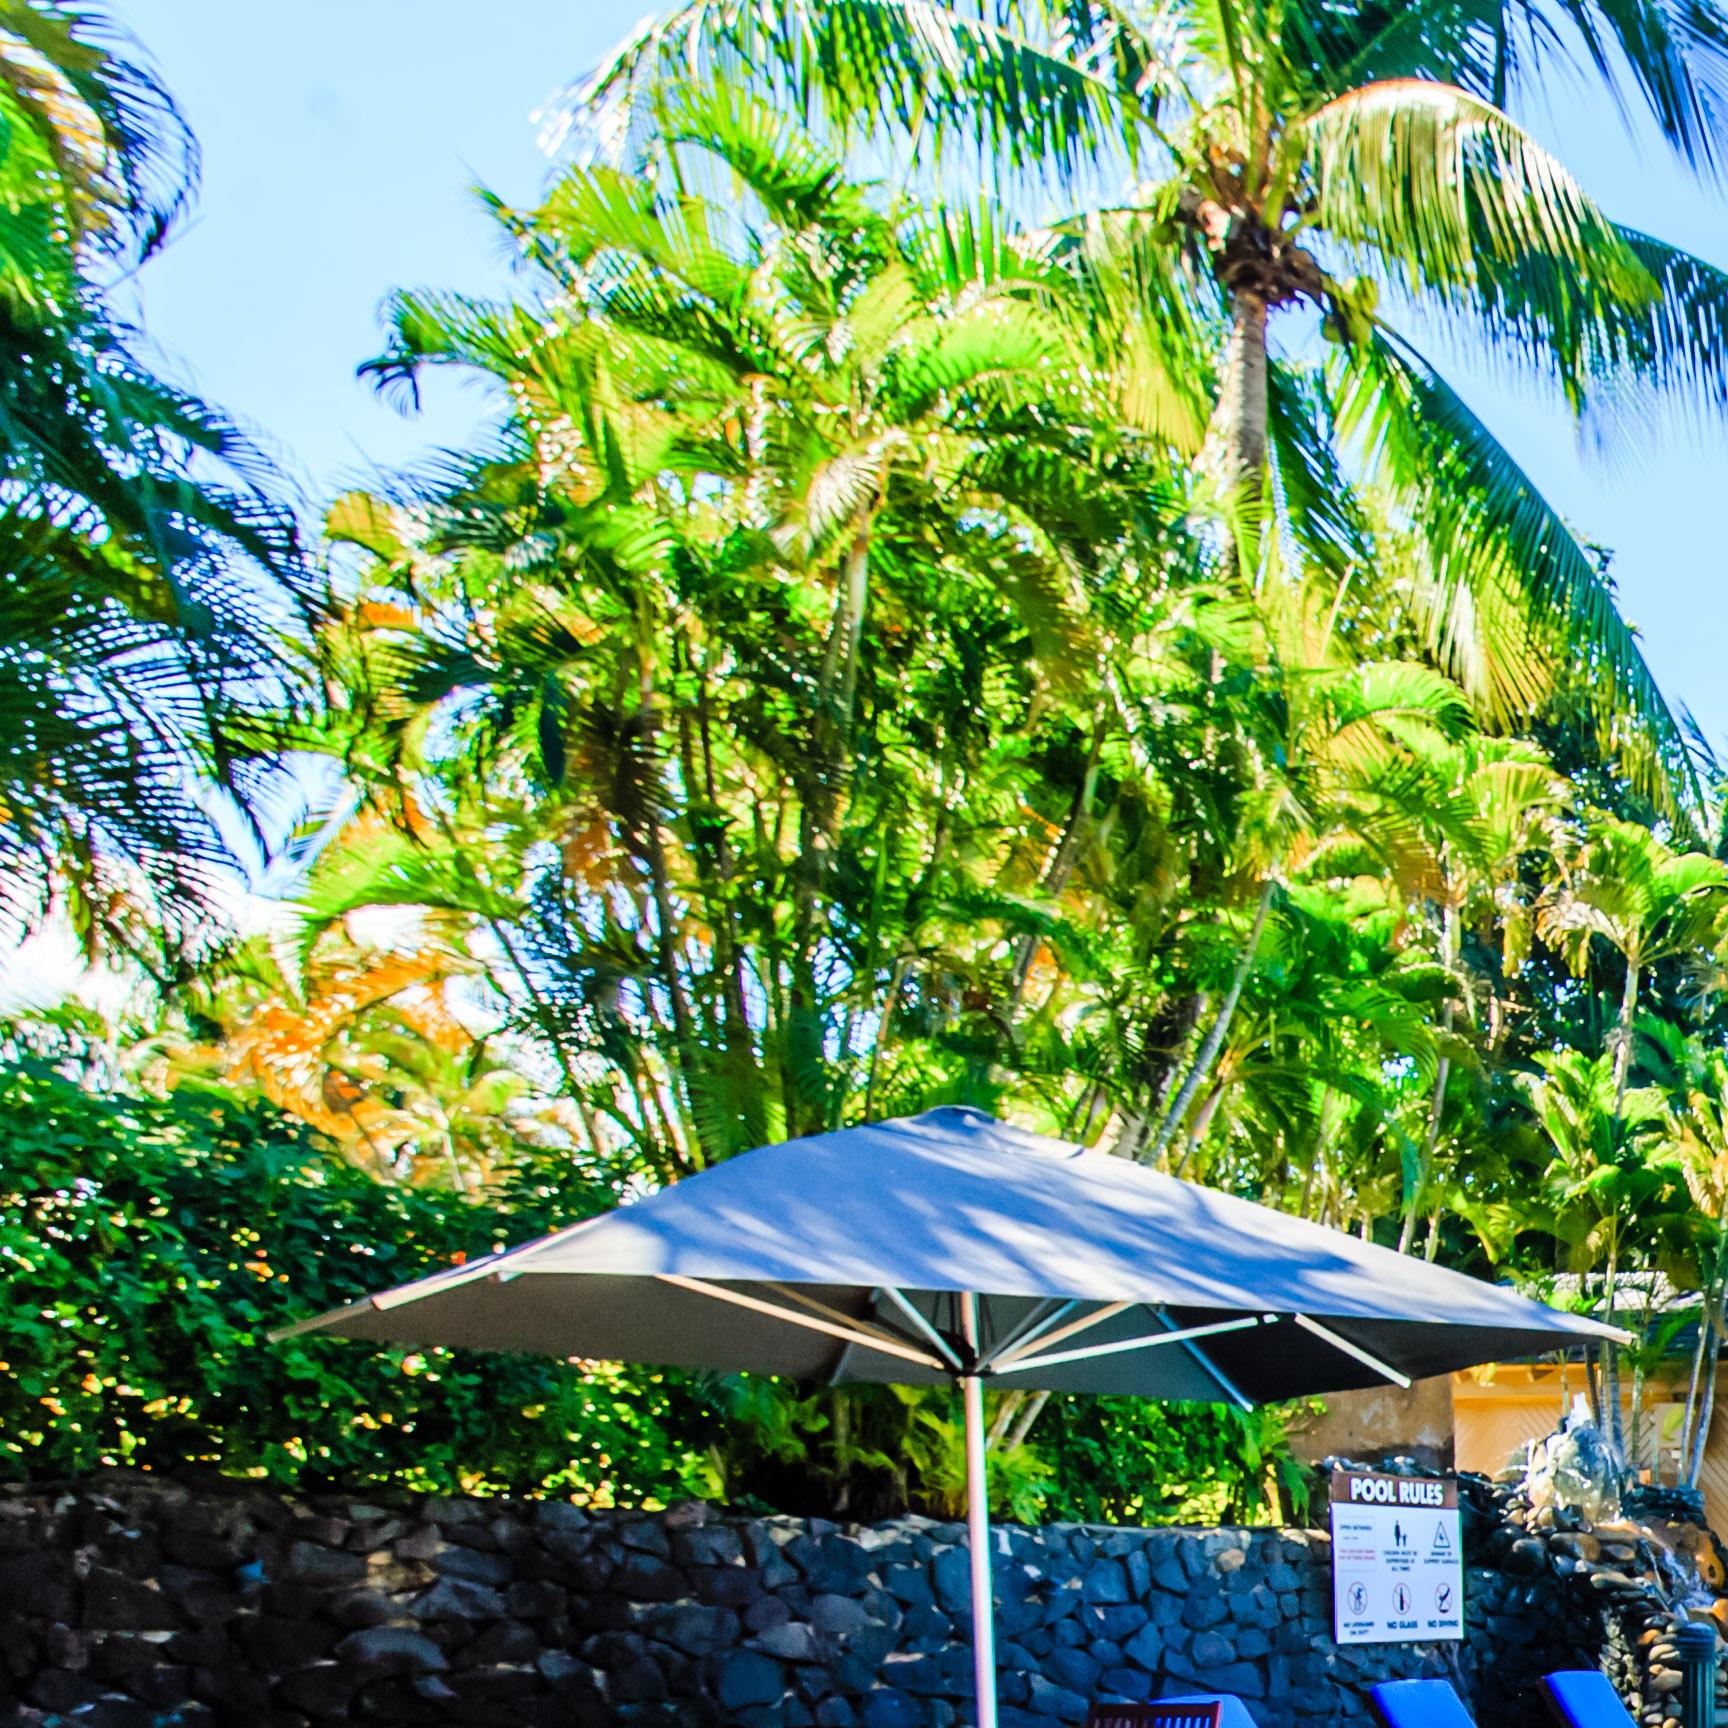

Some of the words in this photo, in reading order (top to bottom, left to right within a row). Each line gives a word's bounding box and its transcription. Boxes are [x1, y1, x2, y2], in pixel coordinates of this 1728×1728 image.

[1350, 1477, 1396, 1502] POOL
[1399, 1481, 1443, 1505] RULES
[1387, 1621, 1398, 1630] NO
[1400, 1620, 1418, 1629] GLASS
[1428, 1620, 1437, 1628] NO
